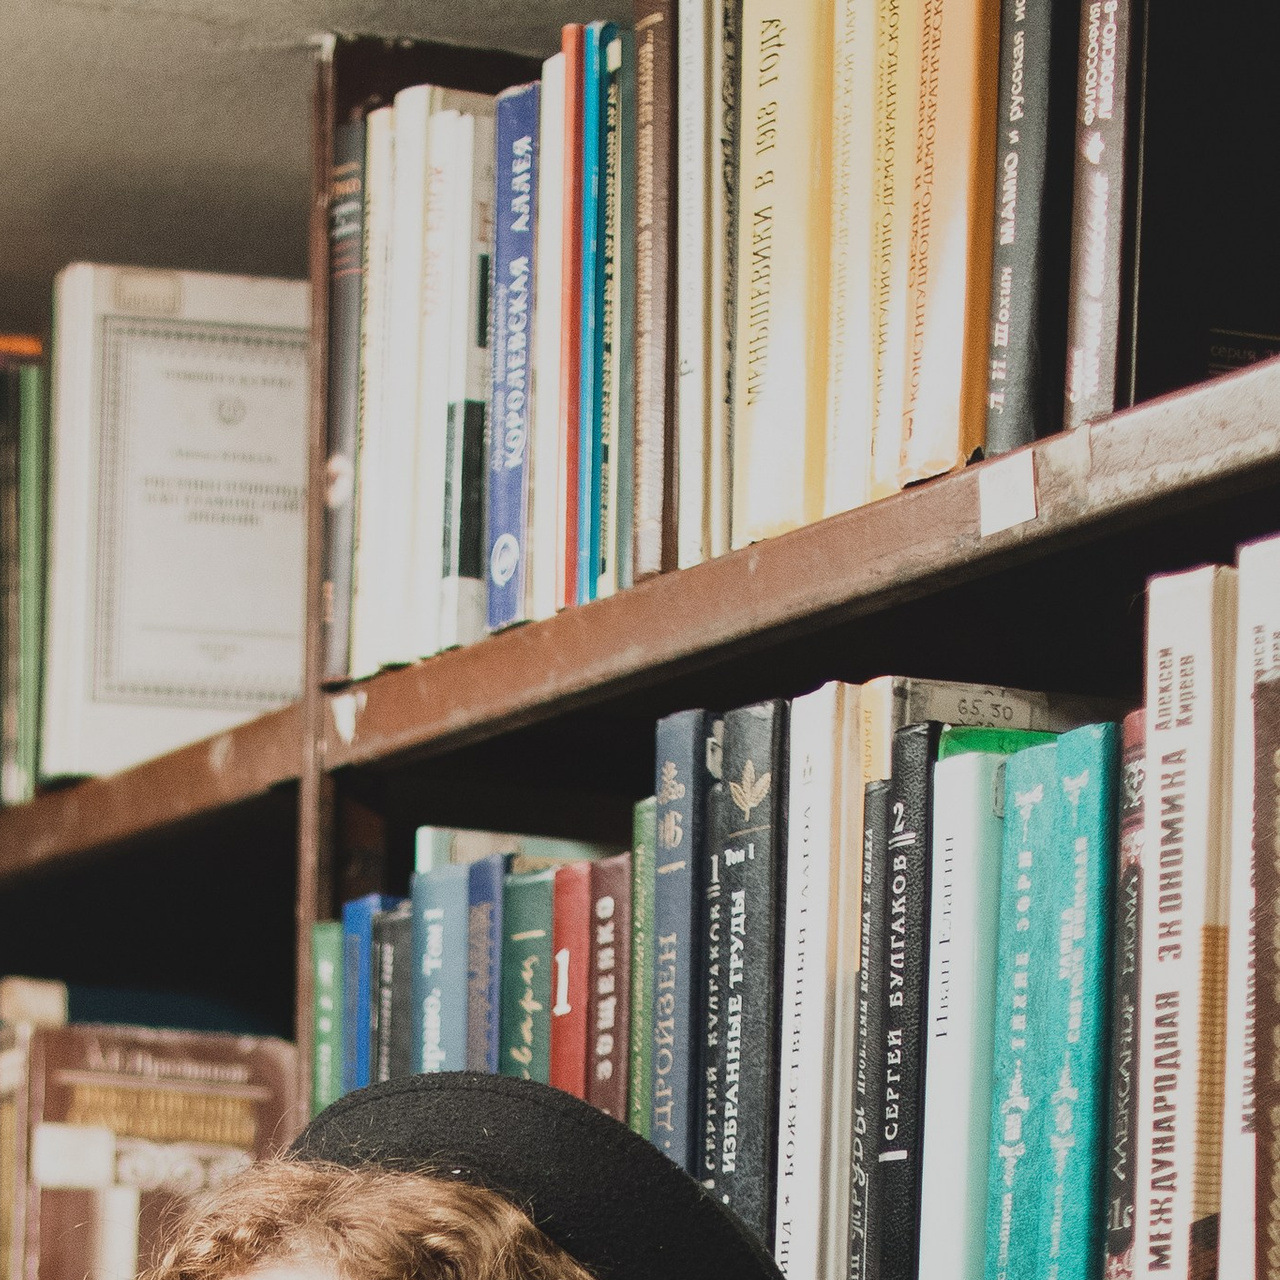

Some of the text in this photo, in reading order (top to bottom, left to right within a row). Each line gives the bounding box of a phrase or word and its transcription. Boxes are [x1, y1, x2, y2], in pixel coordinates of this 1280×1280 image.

[1008, 30, 1026, 122] русская
[1082, 2, 1102, 127] ФИЛОСОФИЯ
[999, 151, 1019, 245] МАМЮ
[1010, 130, 1020, 144] и
[746, 17, 789, 407] МЕНЬШЕВИКИ В 1918 ГОДУ
[504, 134, 533, 469] КОРОЛЕВСКАЯ АЛЛЕЯ
[993, 265, 1013, 348] Шохин
[989, 387, 1006, 414] Л.
[991, 353, 1008, 380] И.
[1154, 646, 1175, 731] Алексей
[1175, 653, 1198, 728] Киреев
[422, 924, 443, 977] Том
[553, 948, 572, 1017] 1
[595, 895, 617, 1081] ЗОЩЕНКО
[706, 902, 721, 1048] БУЛГАКОВ
[784, 927, 807, 1177] БОЖЕСТВЕННЫЙ
[799, 804, 811, 917] ГЛАГОЛ
[884, 802, 908, 1141] СЕРГЕЙ БУЛГАКОВ 2
[935, 836, 955, 1038] Иван Елагин
[654, 932, 678, 1133] ДРОЙЗЕН
[721, 889, 747, 1174] ИЗБРАННЫЕ ТРУДЫ
[1112, 876, 1139, 1182] АЛЕКСАНДР ДЮМА
[1147, 747, 1188, 1272] МЕЖДУНАРОДНАЯ ЭКОНОМИКА
[704, 1065, 718, 1172] СЕРГЕЙ
